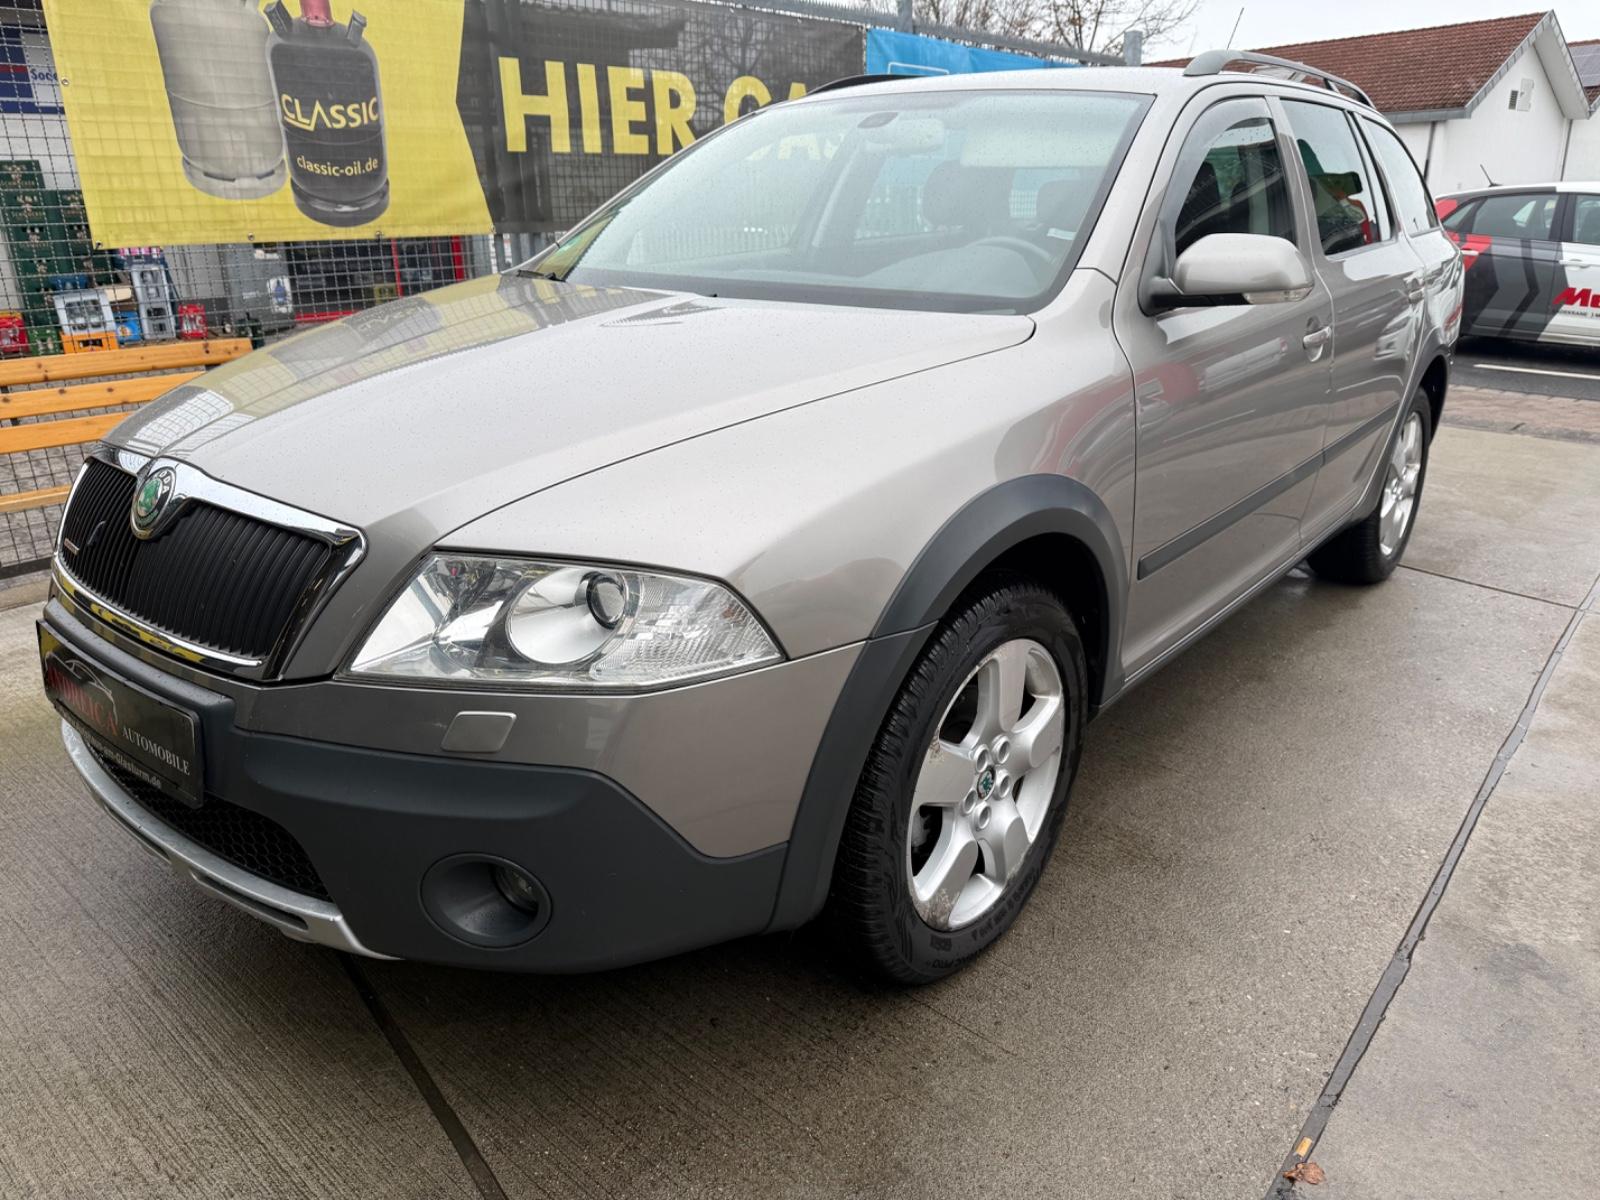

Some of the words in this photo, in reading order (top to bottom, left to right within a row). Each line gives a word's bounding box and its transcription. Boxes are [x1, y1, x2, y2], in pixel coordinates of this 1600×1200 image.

[281, 93, 379, 132] CLASSIC
[498, 56, 697, 155] HIER
[296, 155, 379, 177] classic-oil.de
[122, 725, 191, 776] AUTOMOBILE
